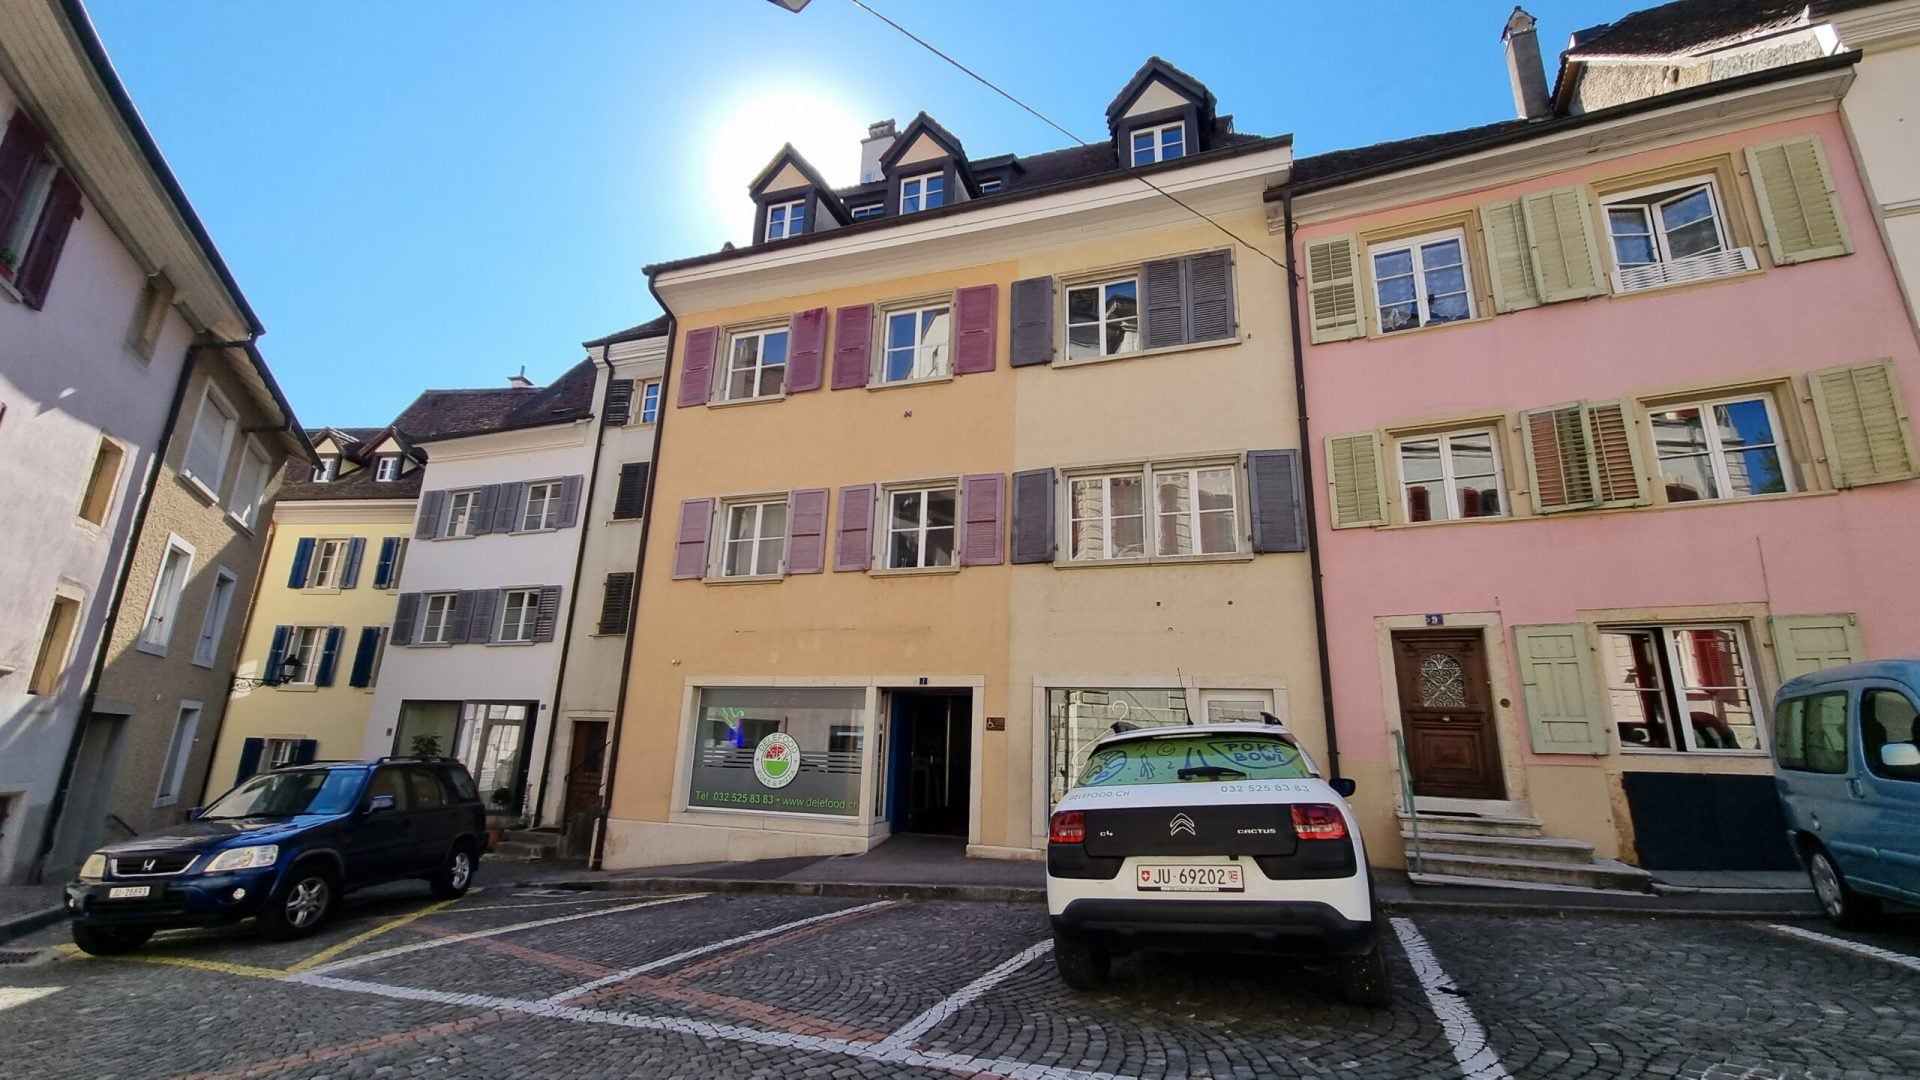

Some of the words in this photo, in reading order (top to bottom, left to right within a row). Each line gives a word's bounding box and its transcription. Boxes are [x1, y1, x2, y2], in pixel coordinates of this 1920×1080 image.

[758, 733, 798, 754] DELEFOOD
[1234, 752, 1285, 763] BOWL
[1221, 785, 1244, 793] 032
[713, 792, 729, 801] 032
[732, 793, 748, 803] 525
[750, 794, 760, 804] 83
[763, 795, 774, 804] 83
[1153, 868, 1171, 884] JU
[1179, 868, 1226, 885] 69202
